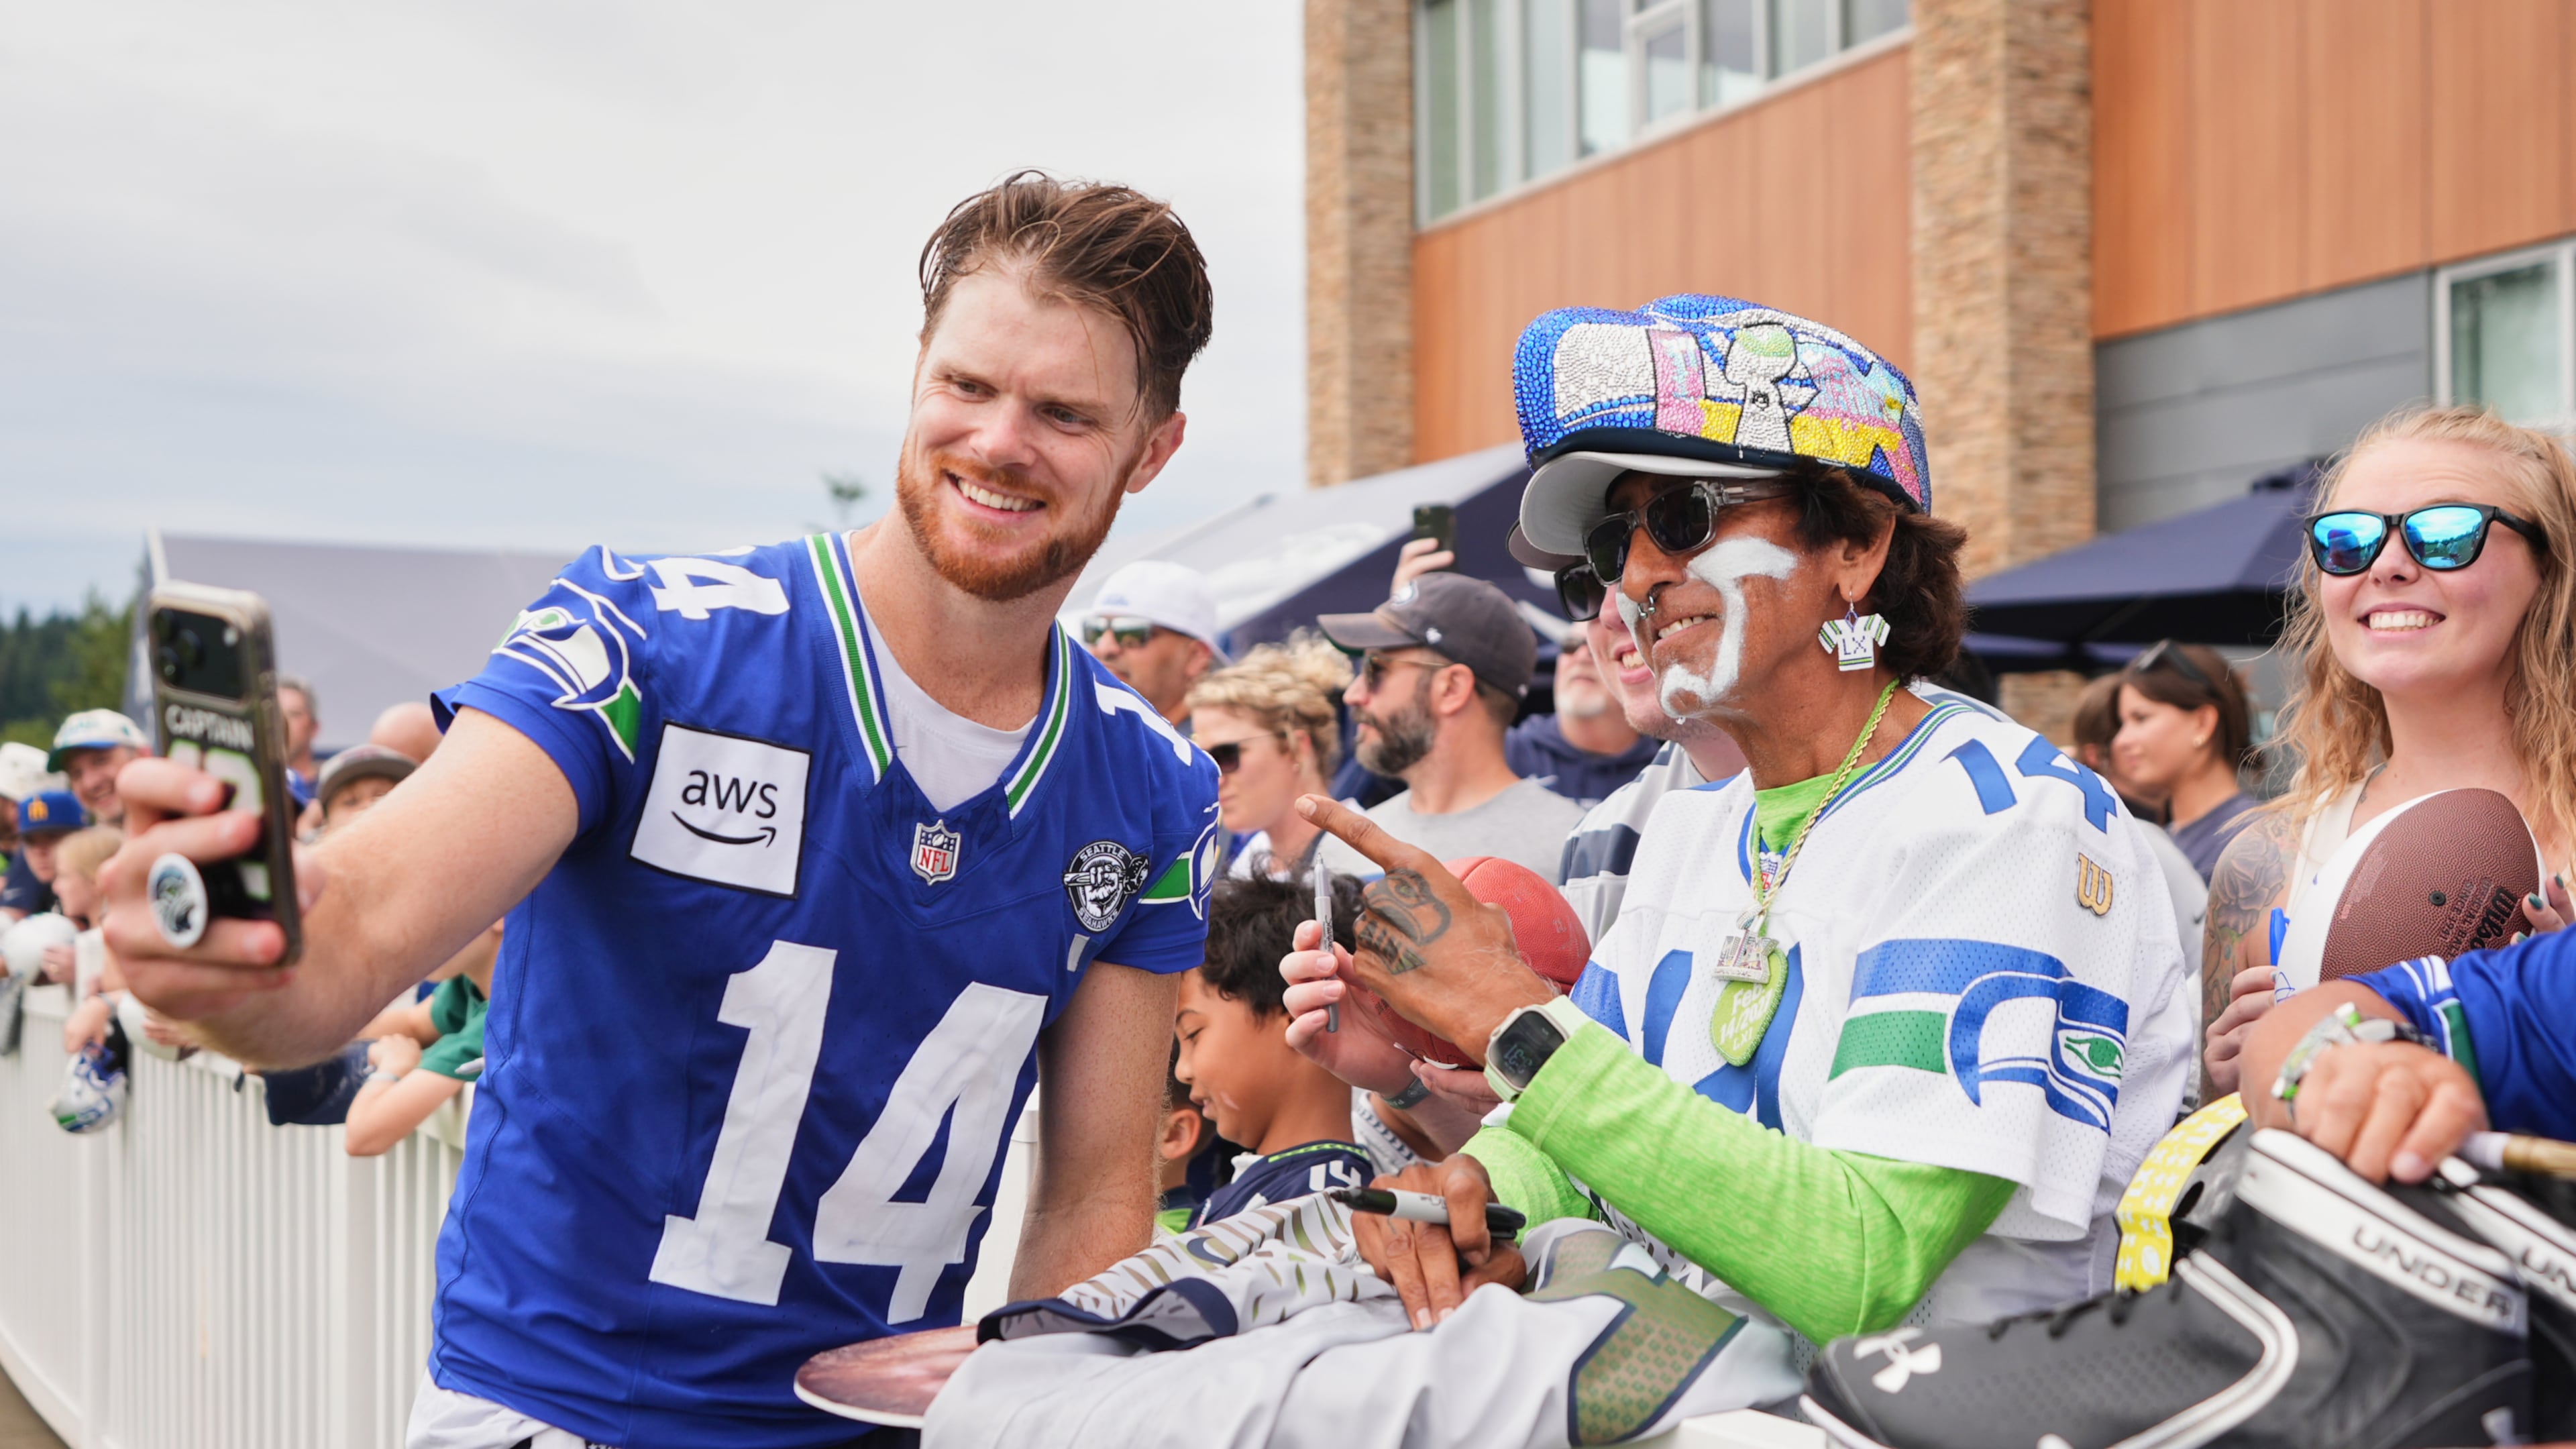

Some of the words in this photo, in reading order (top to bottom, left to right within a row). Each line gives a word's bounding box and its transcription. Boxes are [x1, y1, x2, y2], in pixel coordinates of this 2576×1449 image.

[1842, 635, 1867, 655] LX
[682, 769, 778, 818] aws
[1938, 734, 2118, 835] 14
[919, 847, 950, 873] NFL
[1079, 844, 1126, 862] SEATTLE
[2452, 881, 2475, 916] SINCE
[1078, 908, 1119, 929] SEAHAWKS
[2439, 916, 2458, 941] 1941
[648, 940, 1049, 1325] 14
[2353, 1227, 2512, 1318] UNDER
